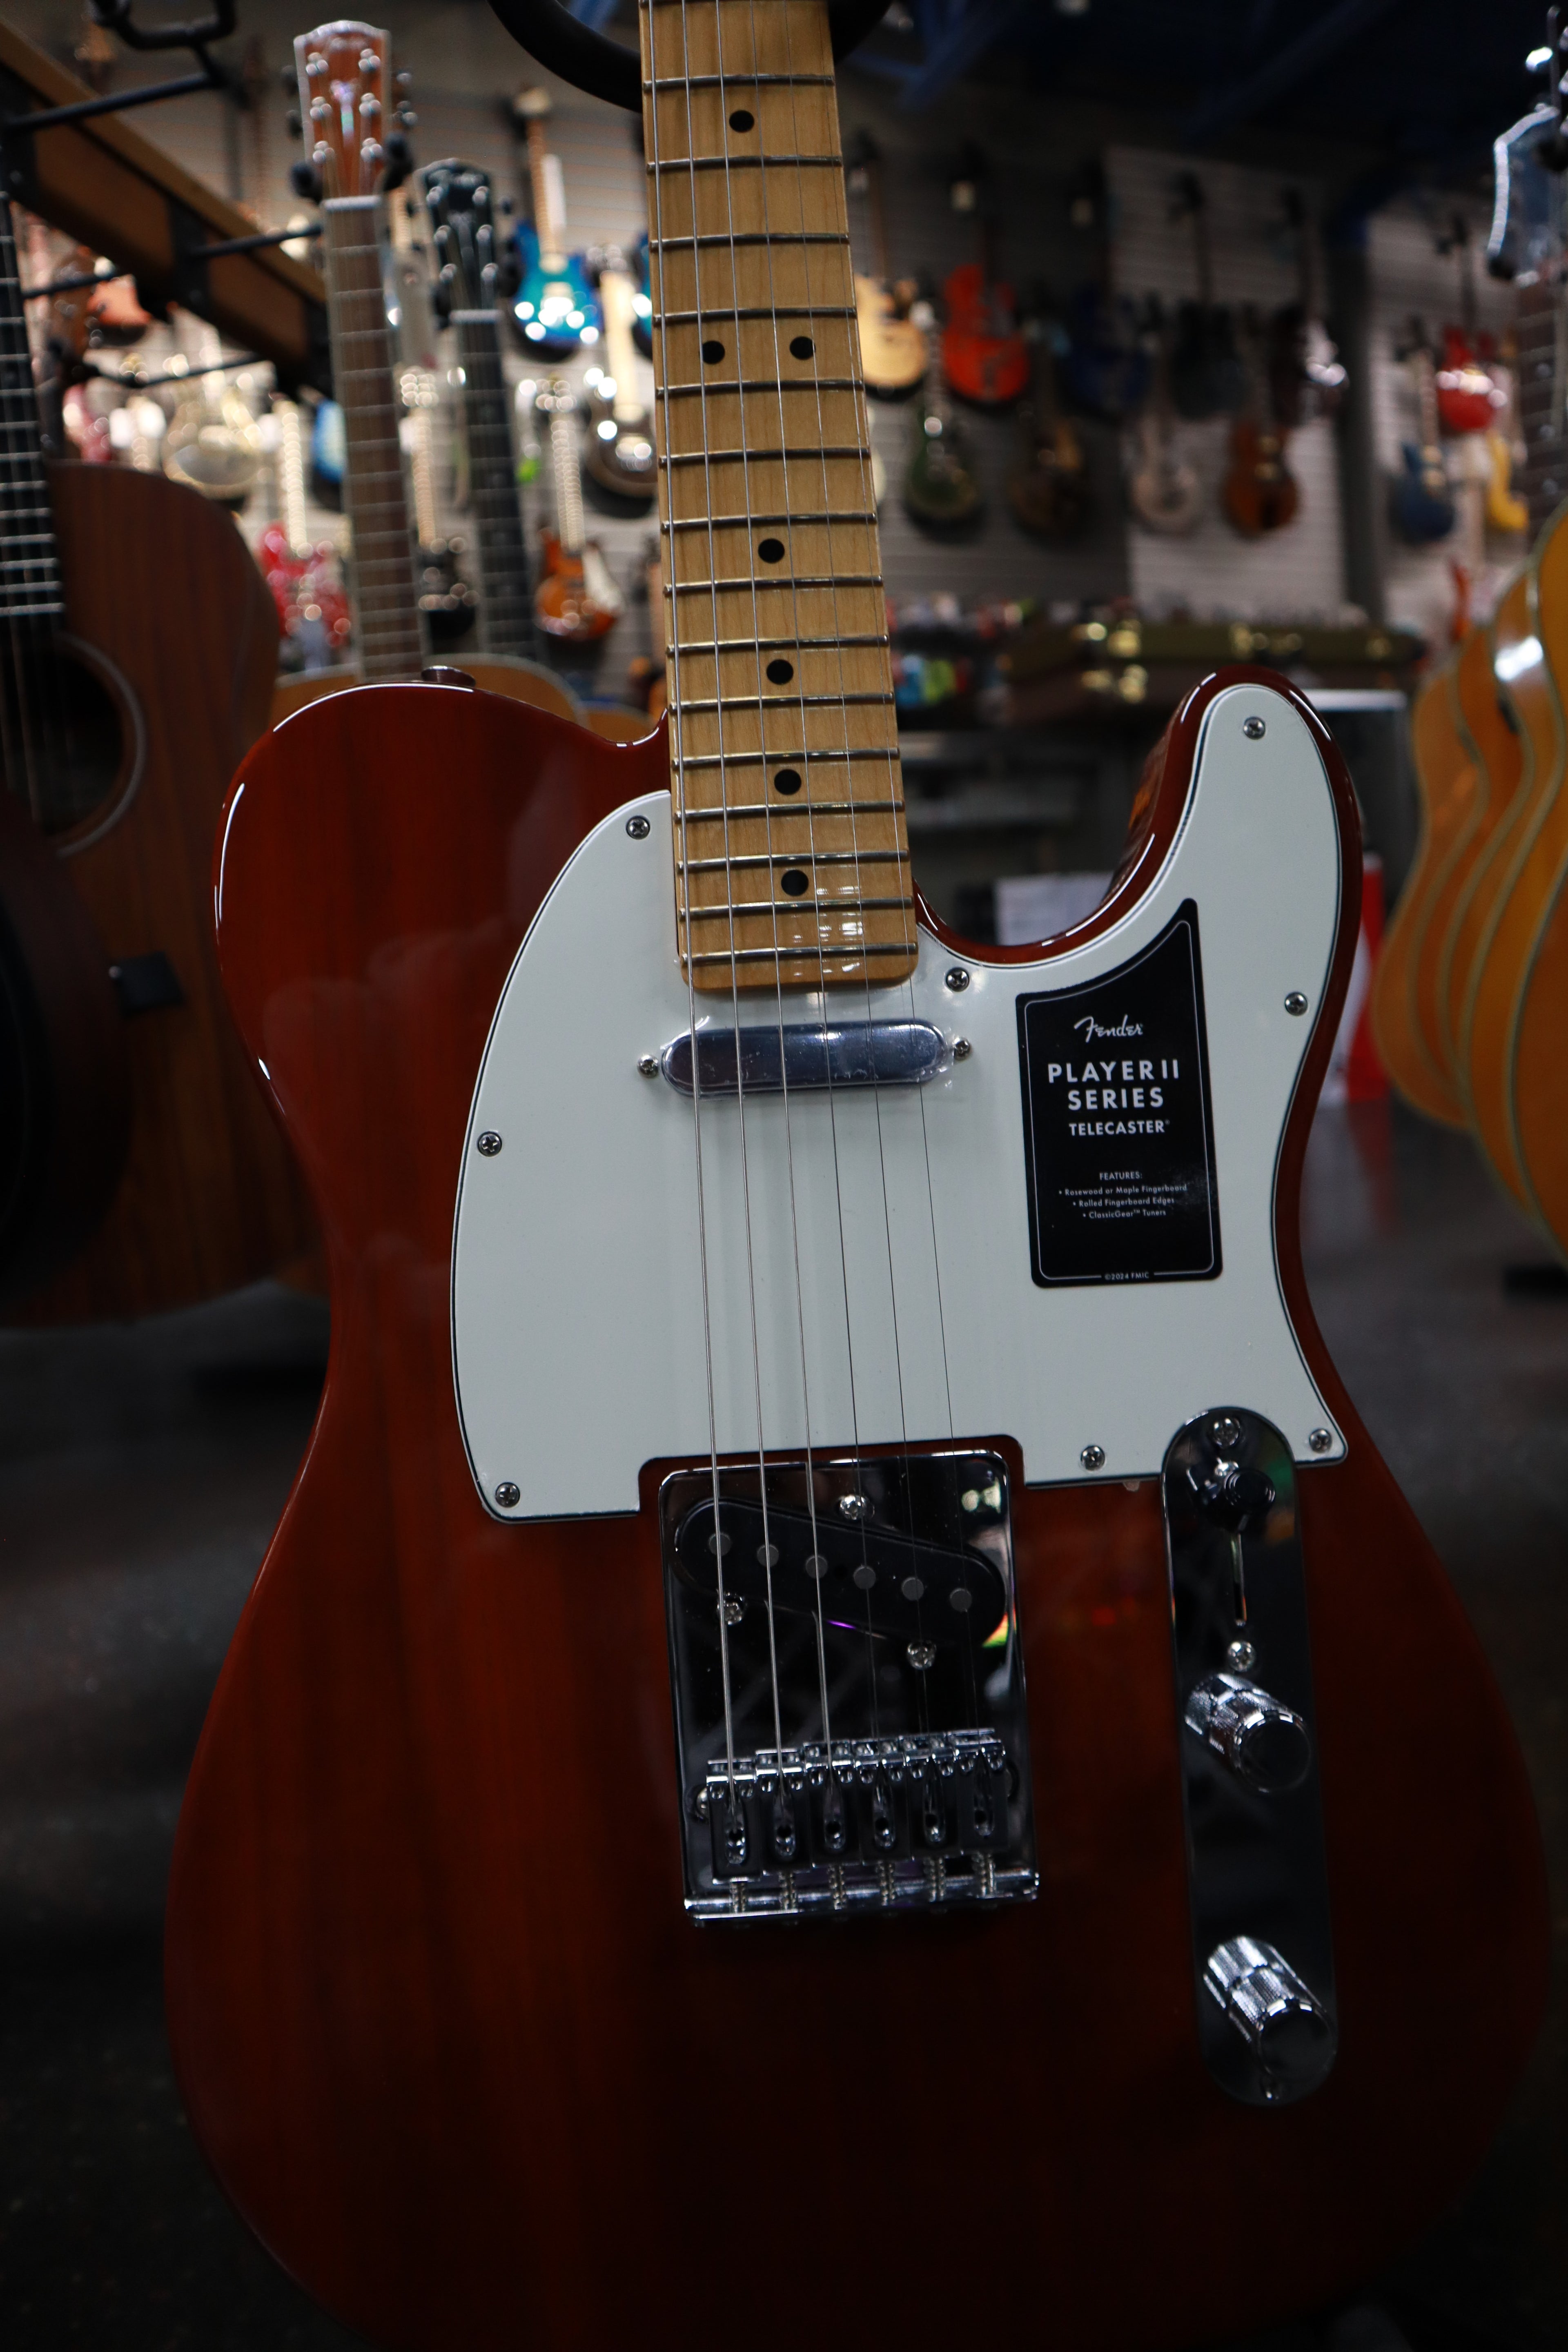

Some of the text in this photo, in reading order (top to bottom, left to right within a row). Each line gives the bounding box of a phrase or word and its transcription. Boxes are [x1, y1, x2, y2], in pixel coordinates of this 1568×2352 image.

[1074, 1014, 1143, 1042] Fender
[1048, 1058, 1179, 1083] PLAYER II
[1068, 1087, 1163, 1110] SERIES
[1099, 1172, 1143, 1180] FEATURES:
[1065, 1187, 1103, 1196] Rosewood
[1116, 1186, 1139, 1195] Maple
[1142, 1184, 1187, 1194] Fingerboard
[1079, 1196, 1174, 1208] Rolled Fingerboard Edges
